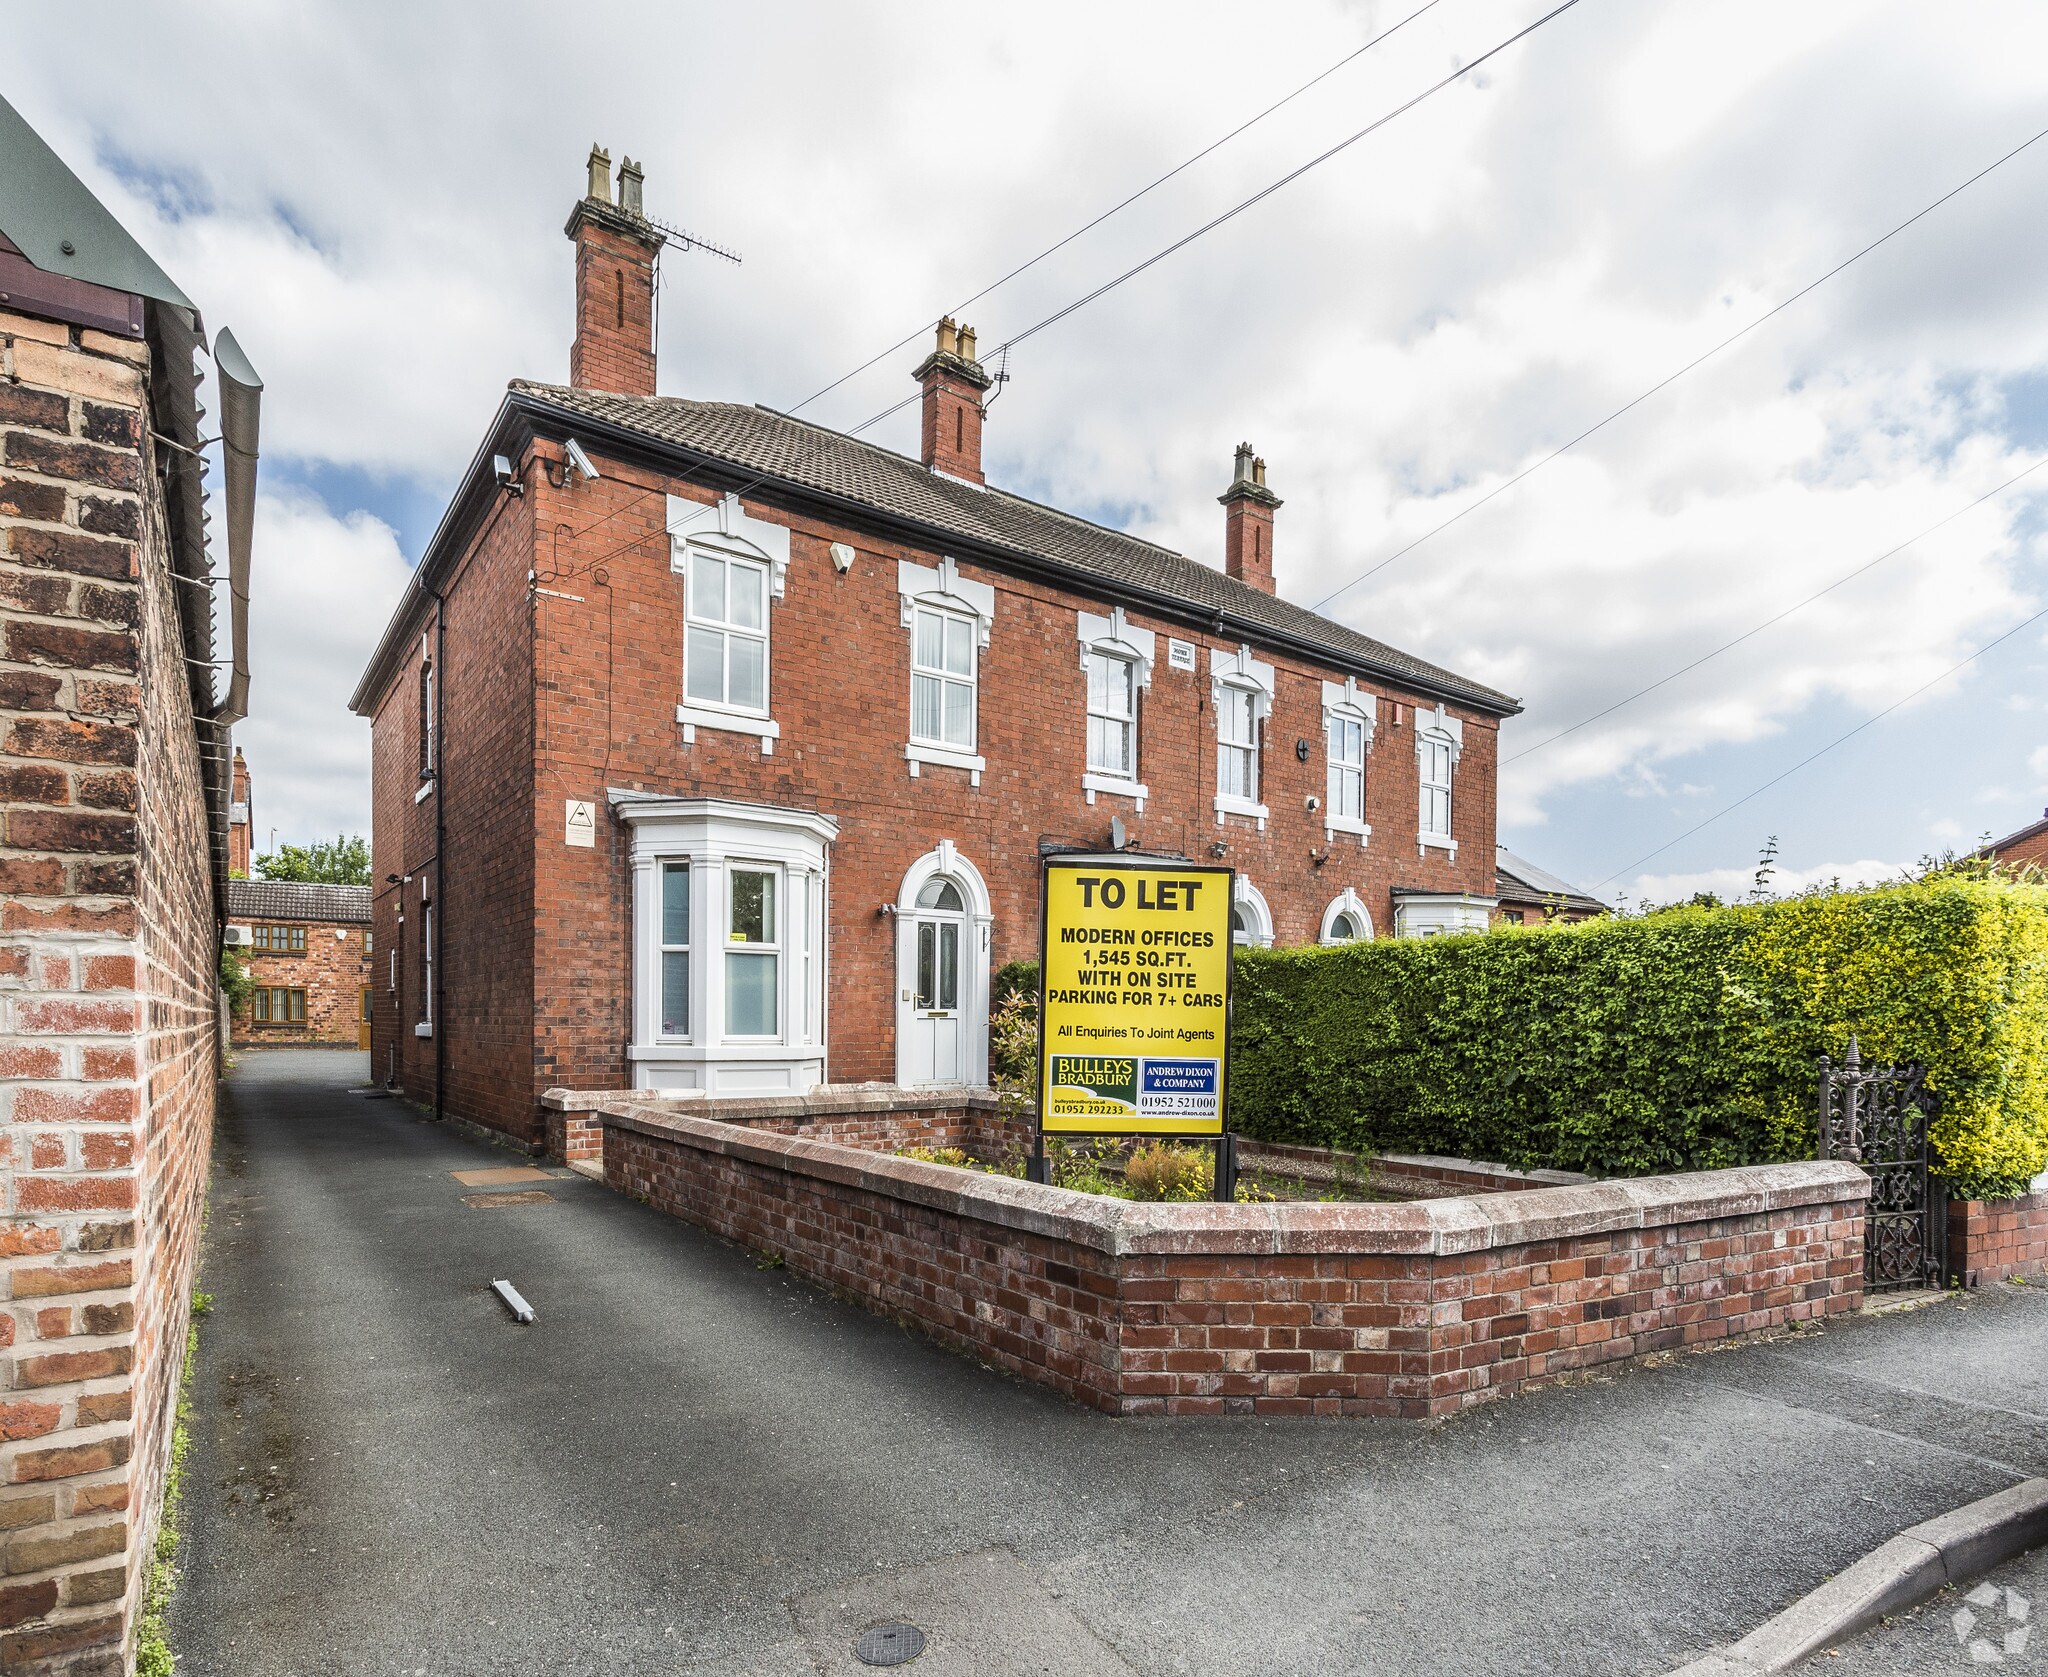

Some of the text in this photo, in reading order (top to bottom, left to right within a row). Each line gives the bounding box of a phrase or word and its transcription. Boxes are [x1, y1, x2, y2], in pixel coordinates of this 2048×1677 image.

[1077, 878, 1202, 911] TO LET
[1061, 928, 1213, 947] MODERN OFFICES
[1084, 950, 1191, 968] 1,545 SQ.FT.
[1078, 970, 1196, 988] WITH ON SITE
[1049, 990, 1222, 1007] PARKING FOR 7+ CARS
[1058, 1026, 1214, 1042] All Enquiries To Joint Agents
[1058, 1059, 1133, 1074] BULLEYS
[1147, 1067, 1213, 1077] ANDREW DIXON
[1058, 1073, 1131, 1086] BRADBURY
[1154, 1078, 1206, 1088] & COMPANY
[1055, 1105, 1123, 1114] 01952 292233
[1142, 1097, 1215, 1108] 01952 521000
